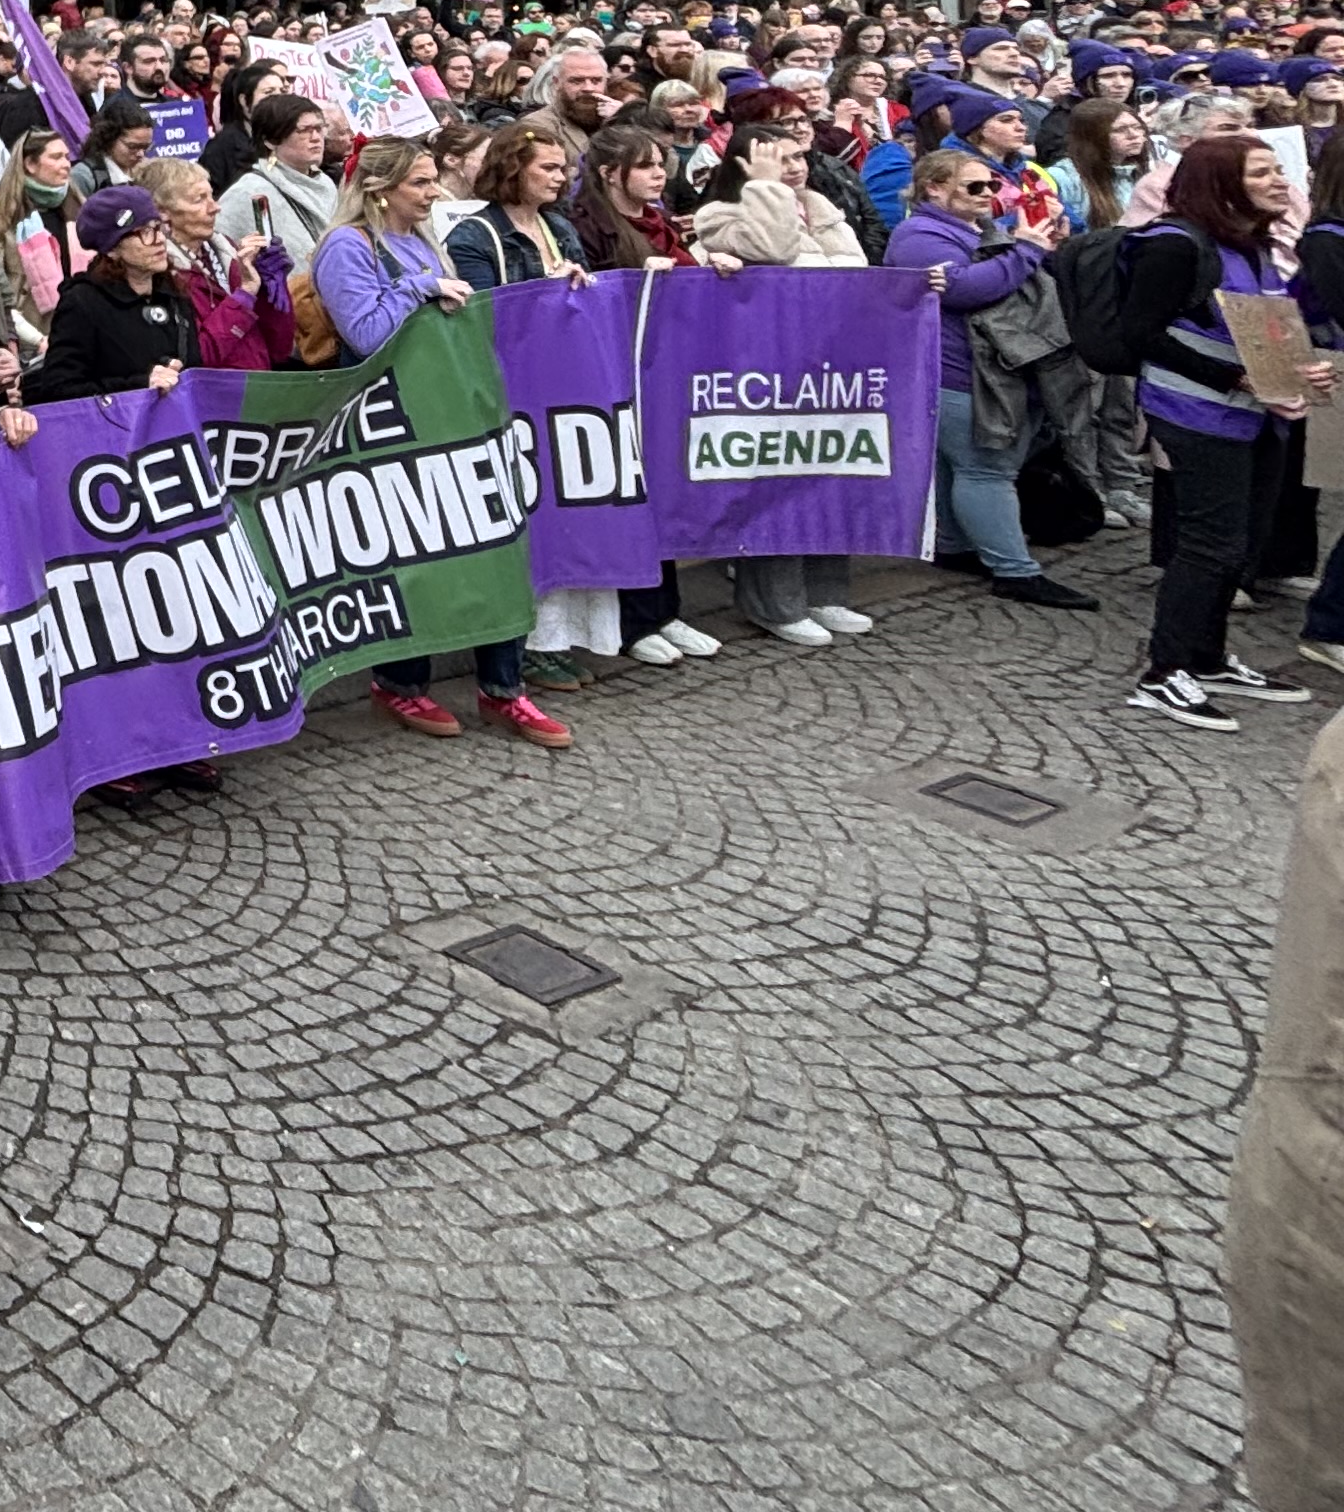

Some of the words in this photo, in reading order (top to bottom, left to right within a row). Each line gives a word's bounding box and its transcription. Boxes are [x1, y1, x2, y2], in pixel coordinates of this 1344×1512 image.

[155, 141, 202, 157] VIOLENCE
[164, 127, 186, 141] END
[867, 367, 889, 408] the
[554, 408, 647, 500] DA
[694, 428, 884, 470] AGENDA
[206, 644, 294, 720] 8TH
